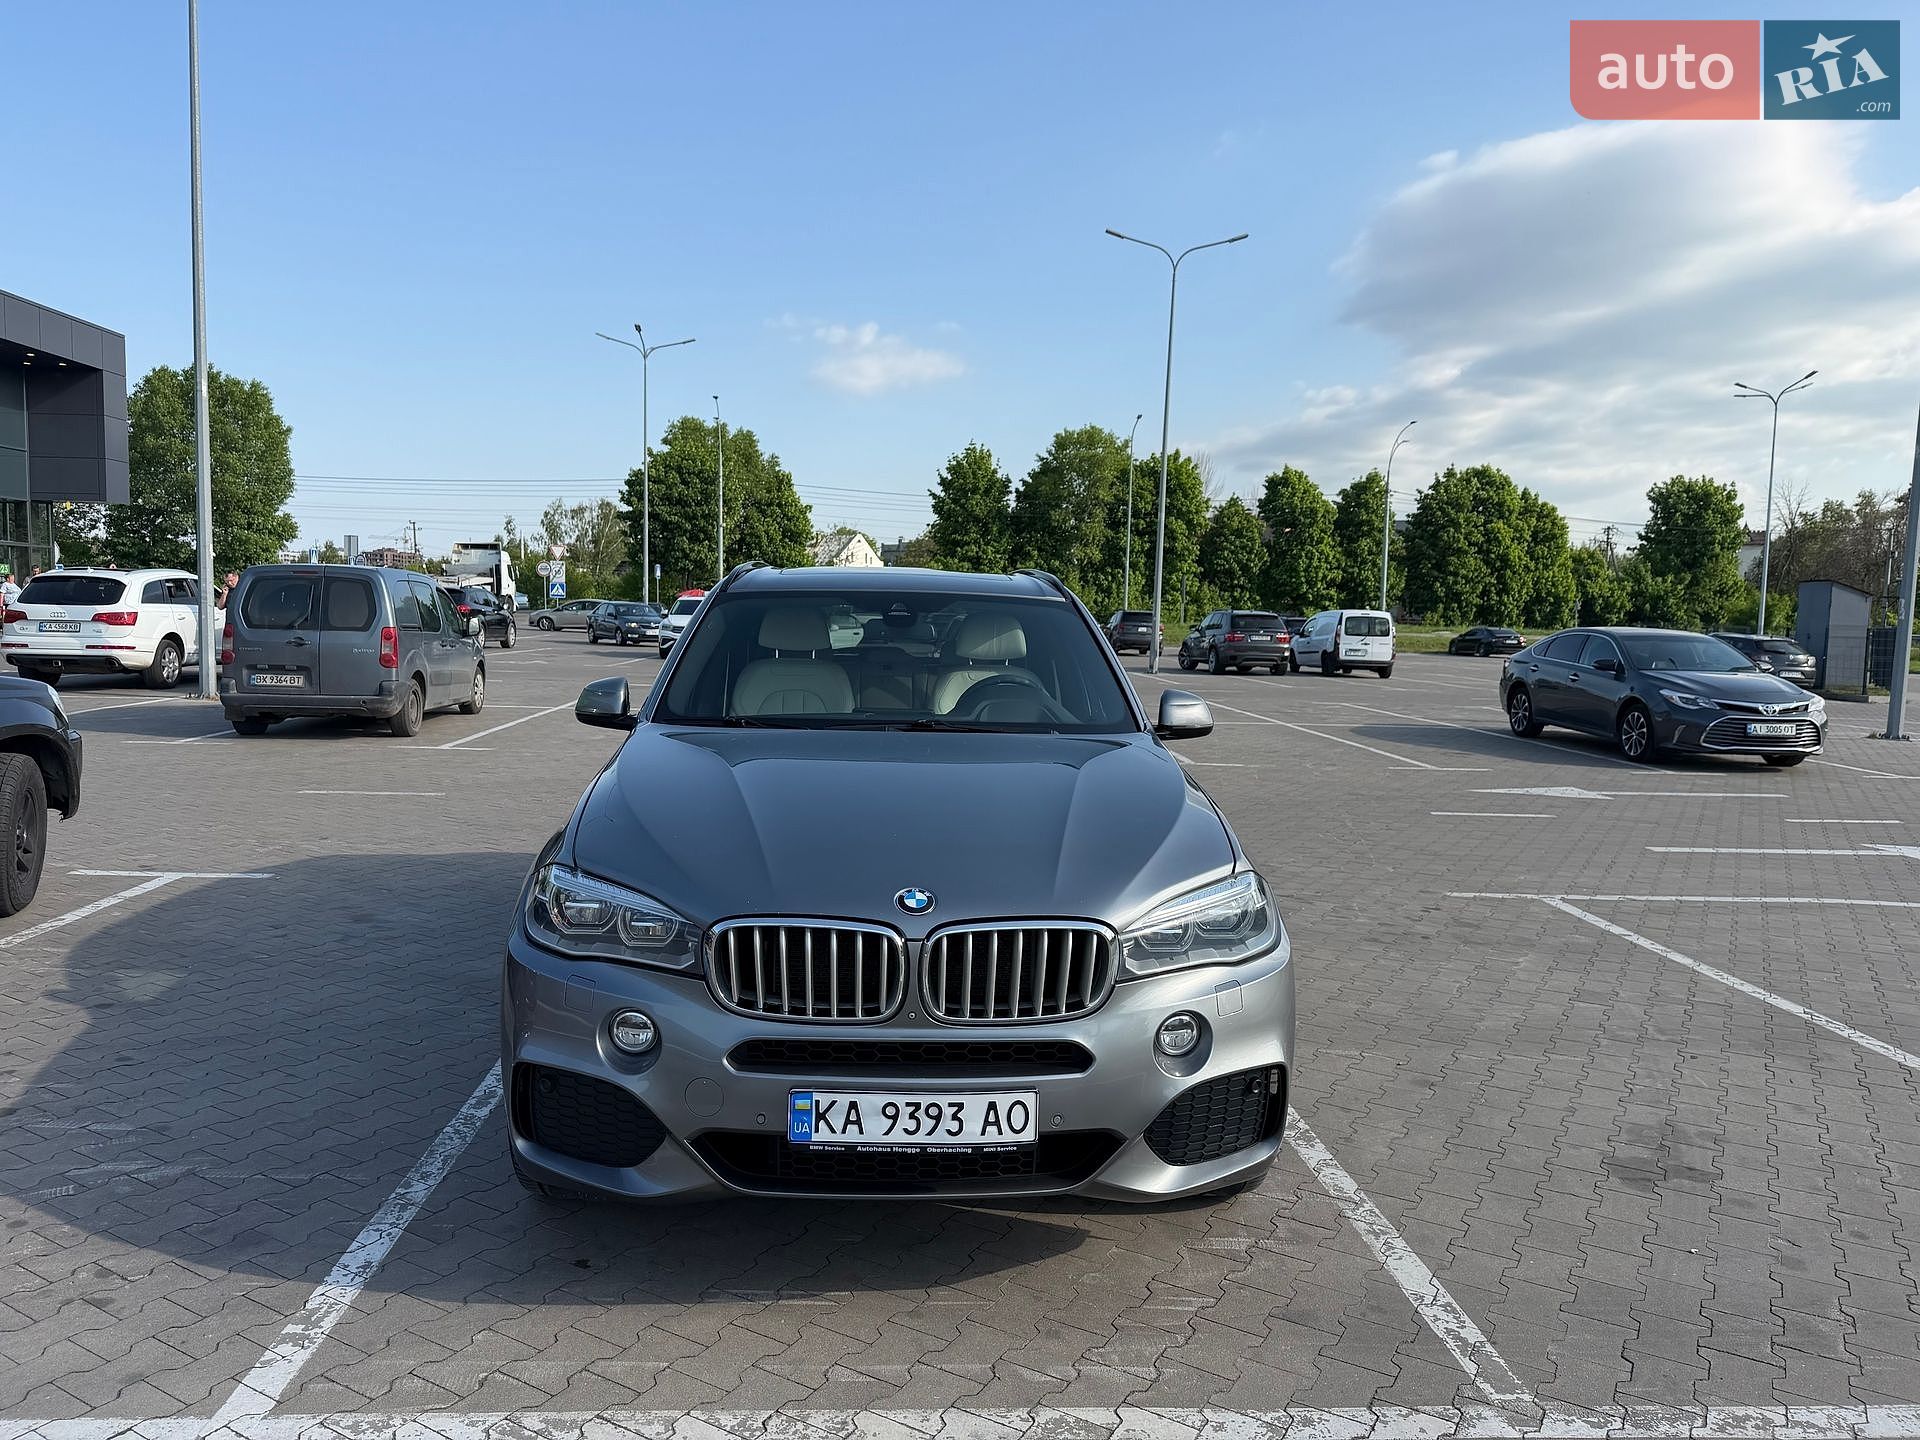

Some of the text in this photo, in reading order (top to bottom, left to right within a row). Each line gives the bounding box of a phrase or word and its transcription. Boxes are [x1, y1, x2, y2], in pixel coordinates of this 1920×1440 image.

[269, 676, 288, 684] 9364
[814, 1099, 1030, 1137] KA 9393 AO
[794, 1122, 810, 1133] UA
